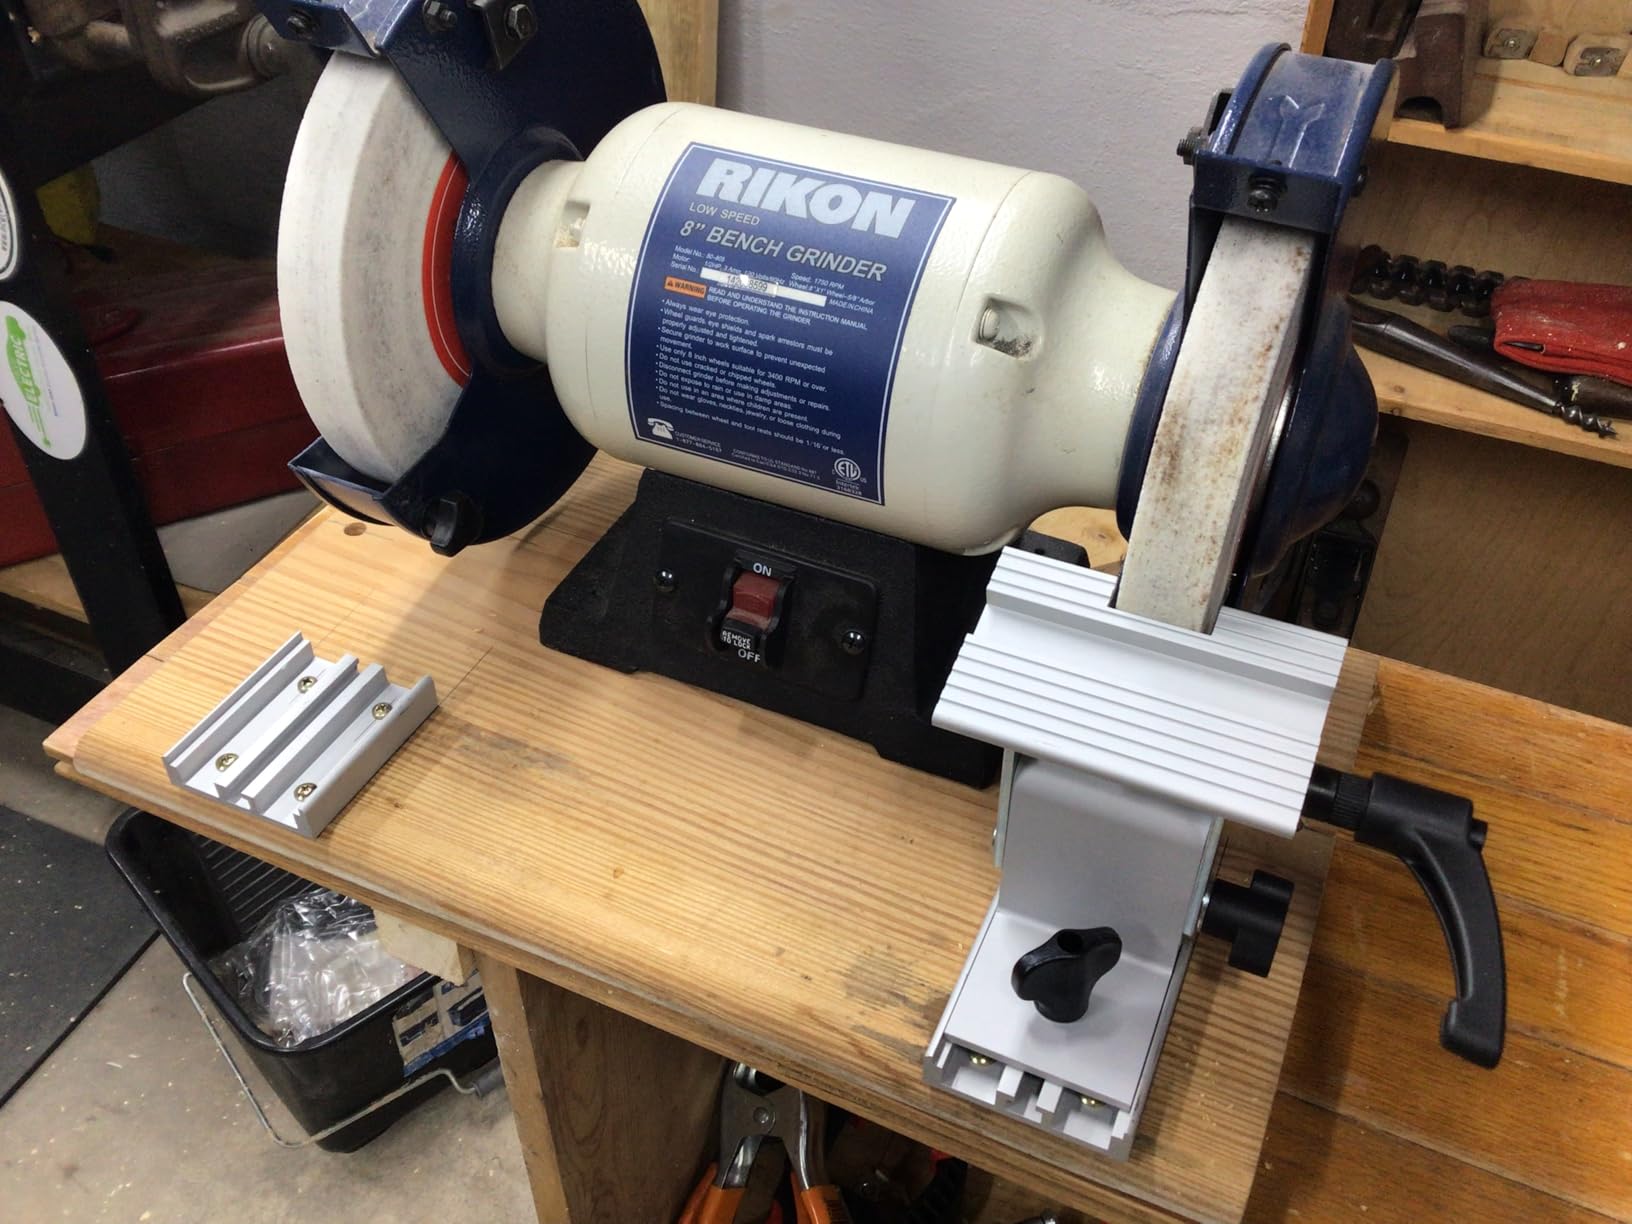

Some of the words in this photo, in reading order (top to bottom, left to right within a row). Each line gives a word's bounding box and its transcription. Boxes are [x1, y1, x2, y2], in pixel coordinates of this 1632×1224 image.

[696, 157, 916, 238] RIKON
[688, 202, 717, 216] LOW
[720, 209, 760, 225] SPEED
[674, 246, 692, 255] Model
[706, 227, 784, 258] BENCH
[785, 244, 887, 281] GRINDER
[674, 282, 704, 294] WARNING
[814, 278, 829, 286] 1750
[828, 281, 844, 290] RPM
[706, 295, 731, 305] BEFORE
[732, 301, 767, 314] OPERATING
[769, 309, 781, 317] THE
[708, 286, 726, 295] READ
[726, 290, 740, 299] AND
[741, 295, 783, 309] UNDERSTAND
[784, 304, 796, 312] THE
[798, 308, 839, 322] INSTRUCTION
[766, 372, 783, 381] 3400
[784, 376, 801, 385] RPM
[753, 562, 772, 577] ON
[722, 630, 751, 644] REMOVE
[733, 640, 751, 650] LOCK
[738, 649, 761, 663] OFF
